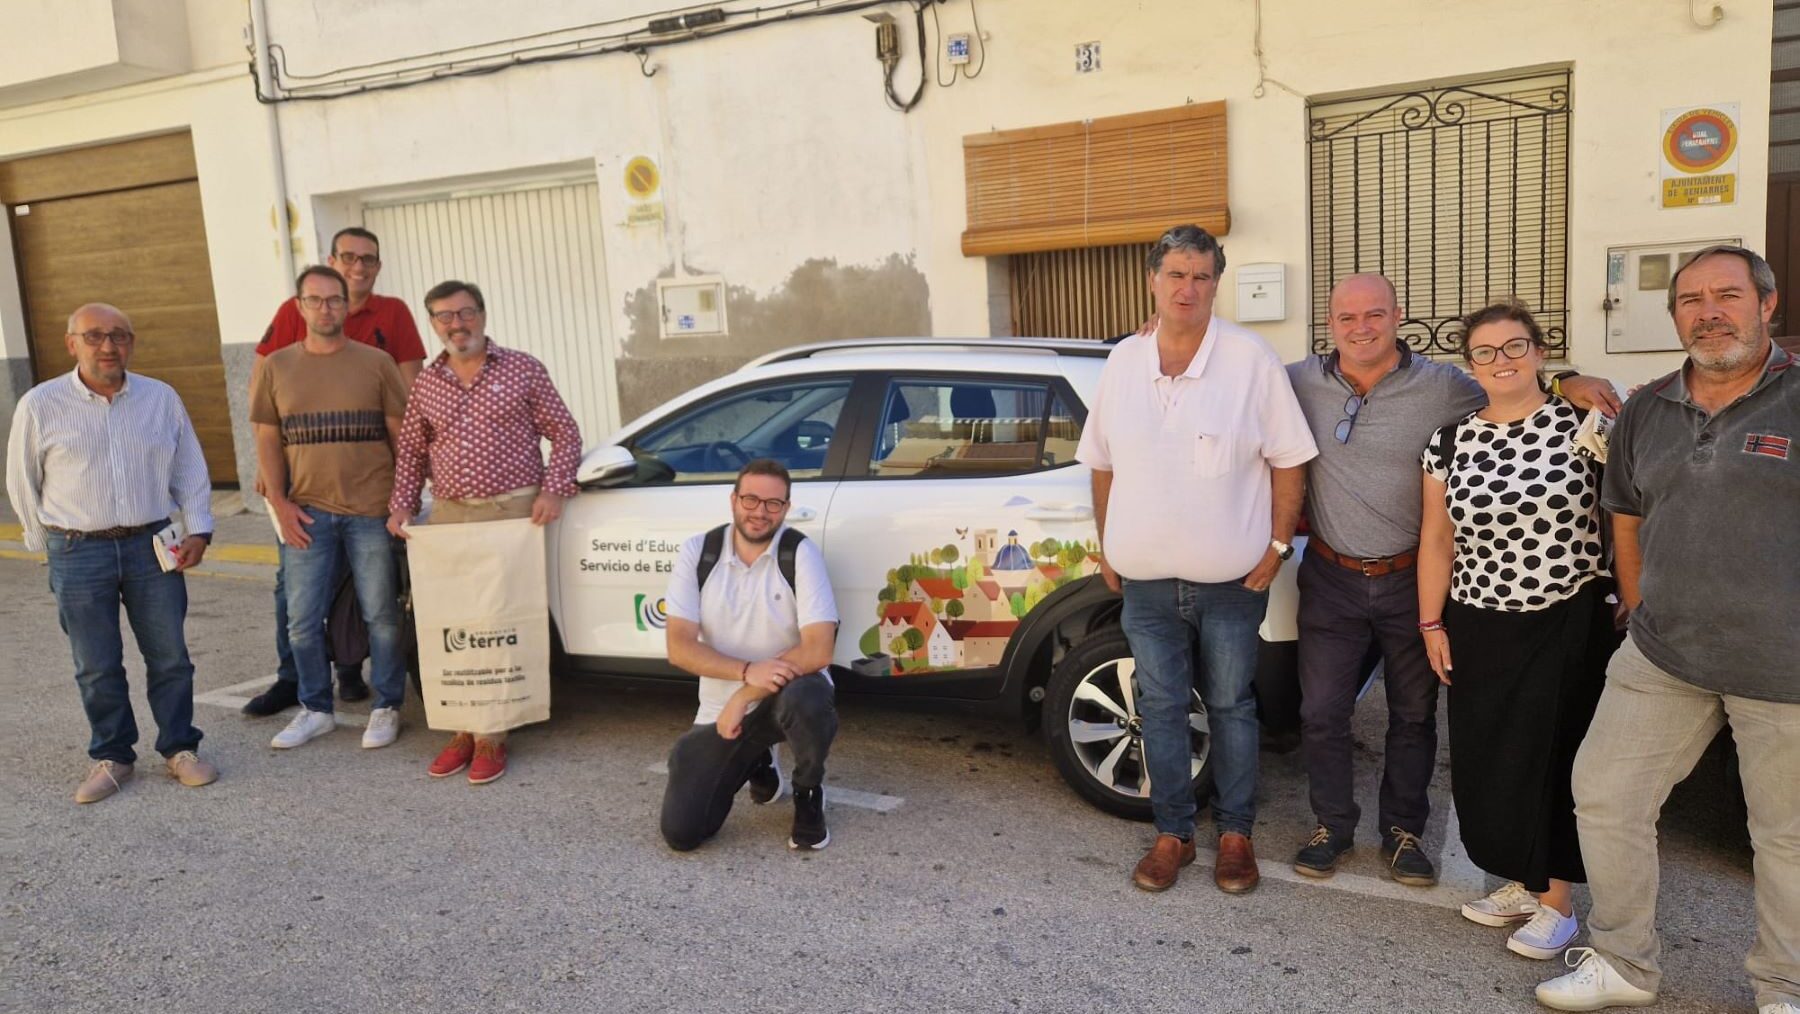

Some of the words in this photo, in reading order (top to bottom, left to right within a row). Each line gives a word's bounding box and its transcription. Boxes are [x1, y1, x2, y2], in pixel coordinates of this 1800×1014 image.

[1671, 175, 1726, 188] AJUNTAMENT
[1668, 189, 1678, 197] DE
[592, 539, 631, 552] Servei
[580, 558, 630, 572] Servicio
[634, 560, 651, 572] de
[655, 560, 674, 573] Ed
[469, 633, 518, 649] terra
